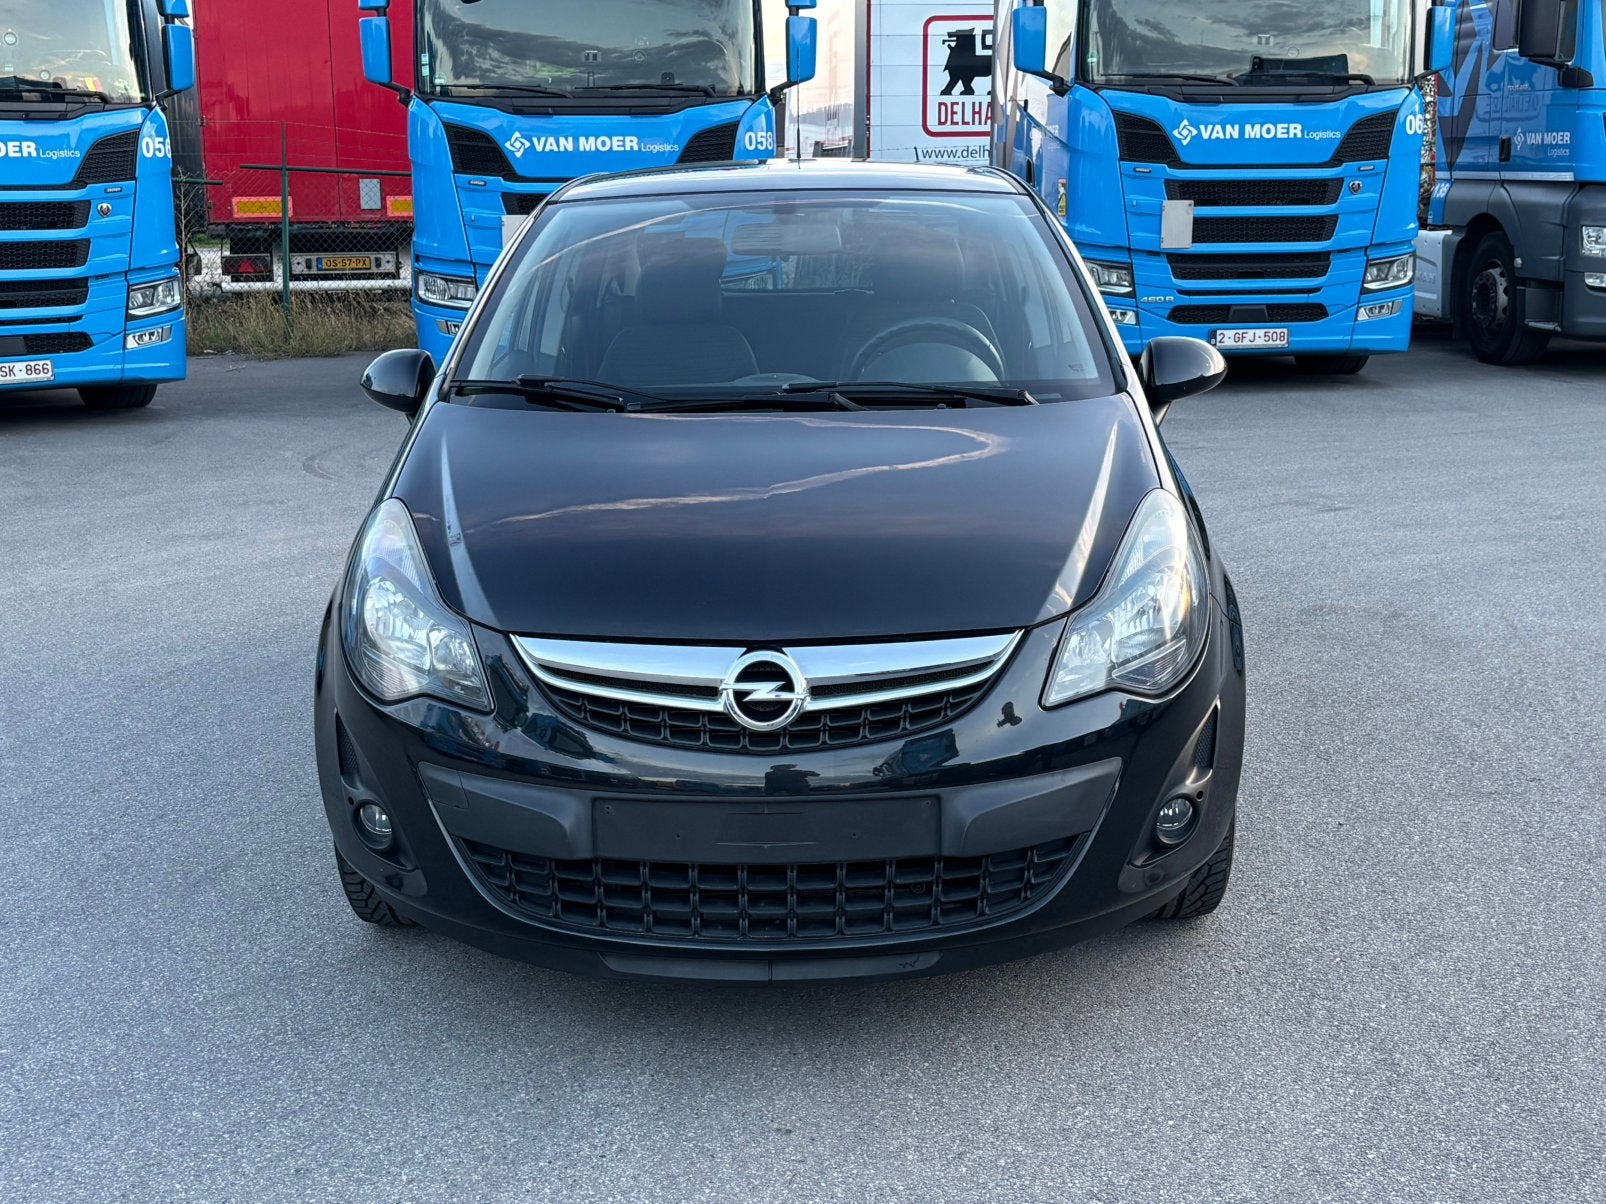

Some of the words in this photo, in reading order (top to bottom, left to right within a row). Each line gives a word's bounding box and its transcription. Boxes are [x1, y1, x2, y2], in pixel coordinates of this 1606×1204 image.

[1199, 124, 1239, 139] VAN
[1244, 123, 1302, 139] MOER
[1304, 130, 1341, 140] Logistics
[1526, 132, 1542, 144] VAN
[1543, 131, 1571, 144] MOER
[532, 136, 574, 152] VAN
[579, 135, 638, 152] MOER
[641, 142, 679, 153] Logistics
[744, 131, 774, 150] 058
[40, 148, 80, 160] Logistics
